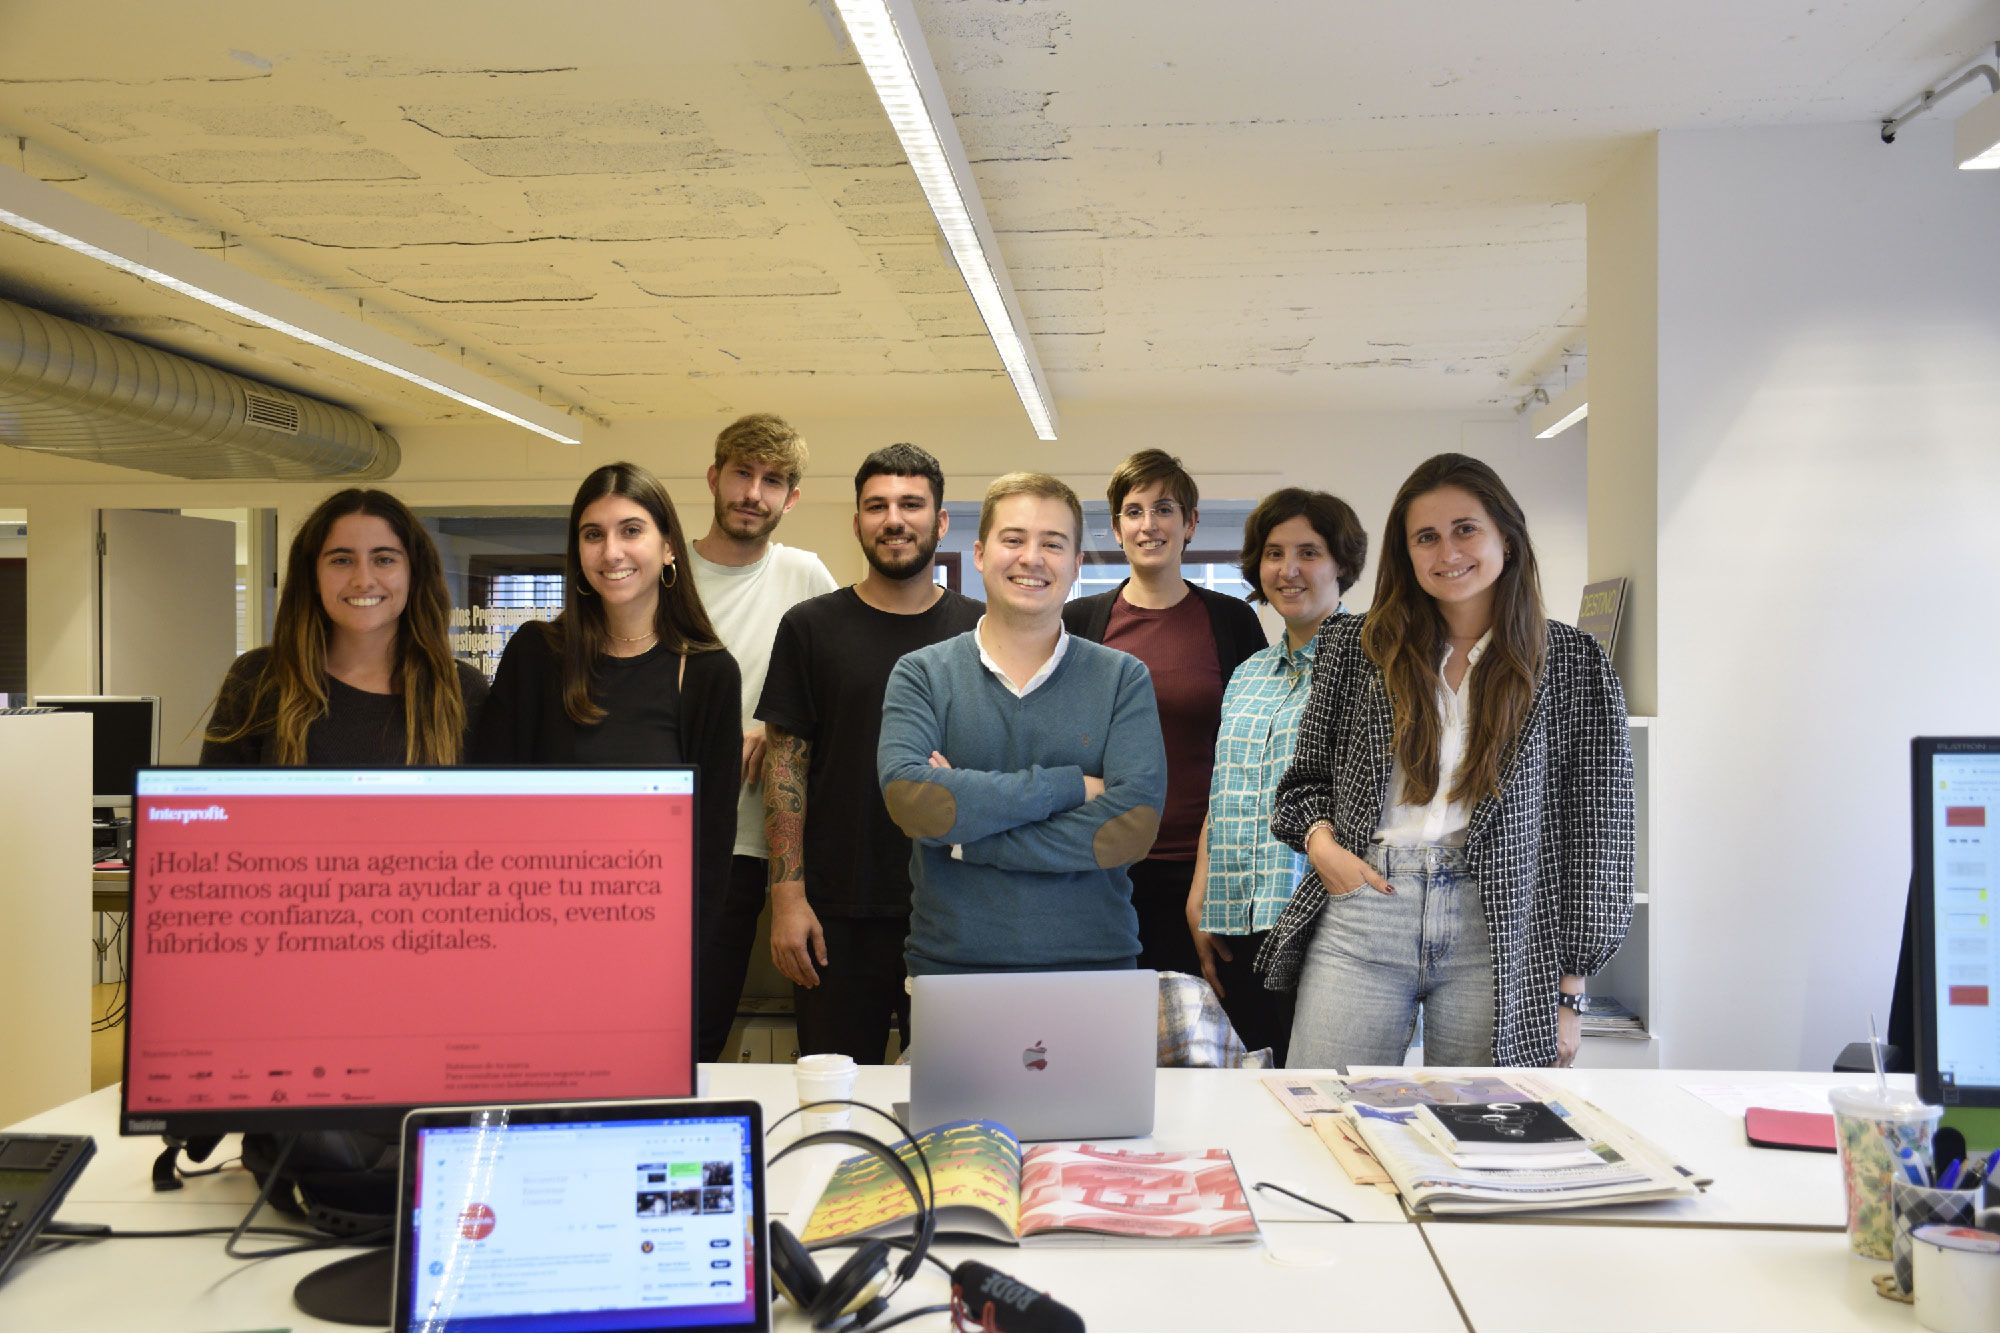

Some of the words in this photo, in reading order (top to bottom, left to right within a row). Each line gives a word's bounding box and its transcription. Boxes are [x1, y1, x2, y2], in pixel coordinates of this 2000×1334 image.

[1580, 588, 1617, 618] DESTINO
[149, 851, 220, 876] ¡Hola!
[227, 850, 308, 873] Somos
[315, 853, 360, 872] una
[367, 851, 458, 876] agencia
[465, 849, 494, 871] de
[501, 849, 663, 870] comunicación
[147, 882, 163, 903] y
[170, 880, 271, 899] estamos
[279, 877, 332, 902] aquí
[338, 880, 391, 902] para
[398, 876, 482, 901] ayudar
[488, 880, 500, 896] a
[508, 879, 552, 902] que
[559, 877, 583, 896] tu
[590, 878, 662, 896] marca
[146, 909, 233, 931] genere
[240, 904, 363, 927] confianza,
[370, 907, 413, 925] con
[421, 902, 558, 926] contenidos,
[566, 903, 656, 922] eventos
[146, 931, 248, 955] híbridos
[254, 936, 270, 957] y
[277, 930, 385, 953] formatos
[392, 928, 497, 955] digitales.
